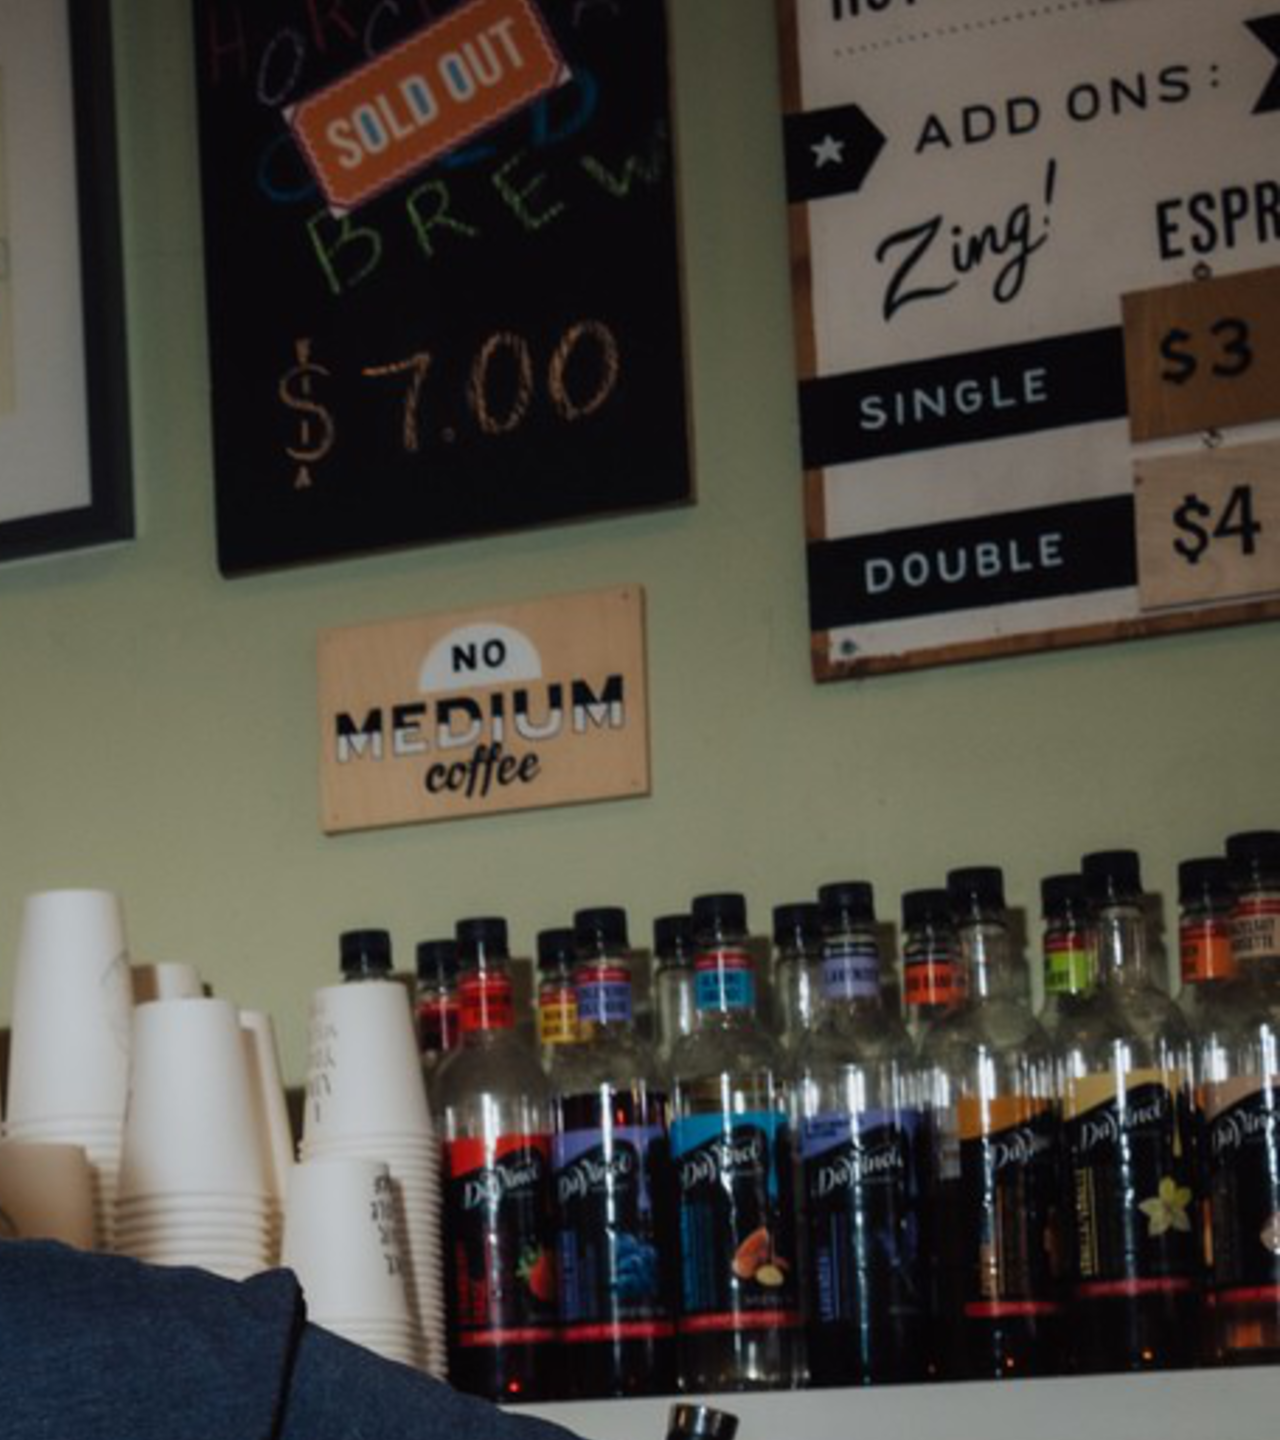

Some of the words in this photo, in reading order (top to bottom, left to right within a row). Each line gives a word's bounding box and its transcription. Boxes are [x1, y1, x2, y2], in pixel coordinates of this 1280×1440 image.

[326, 72, 439, 171] SOLD
[439, 17, 527, 98] OUT
[915, 98, 1040, 153] ADD
[1066, 64, 1219, 122] ONS:
[306, 120, 670, 293] BREW
[876, 158, 1056, 321] Zing!
[858, 367, 1049, 432] SINGLE
[1160, 318, 1252, 385] $3
[864, 531, 1065, 593] DOUBLE
[1173, 486, 1261, 562] $4
[452, 639, 506, 673] NO
[336, 675, 625, 763] MEDIUM
[425, 744, 540, 797] coffee
